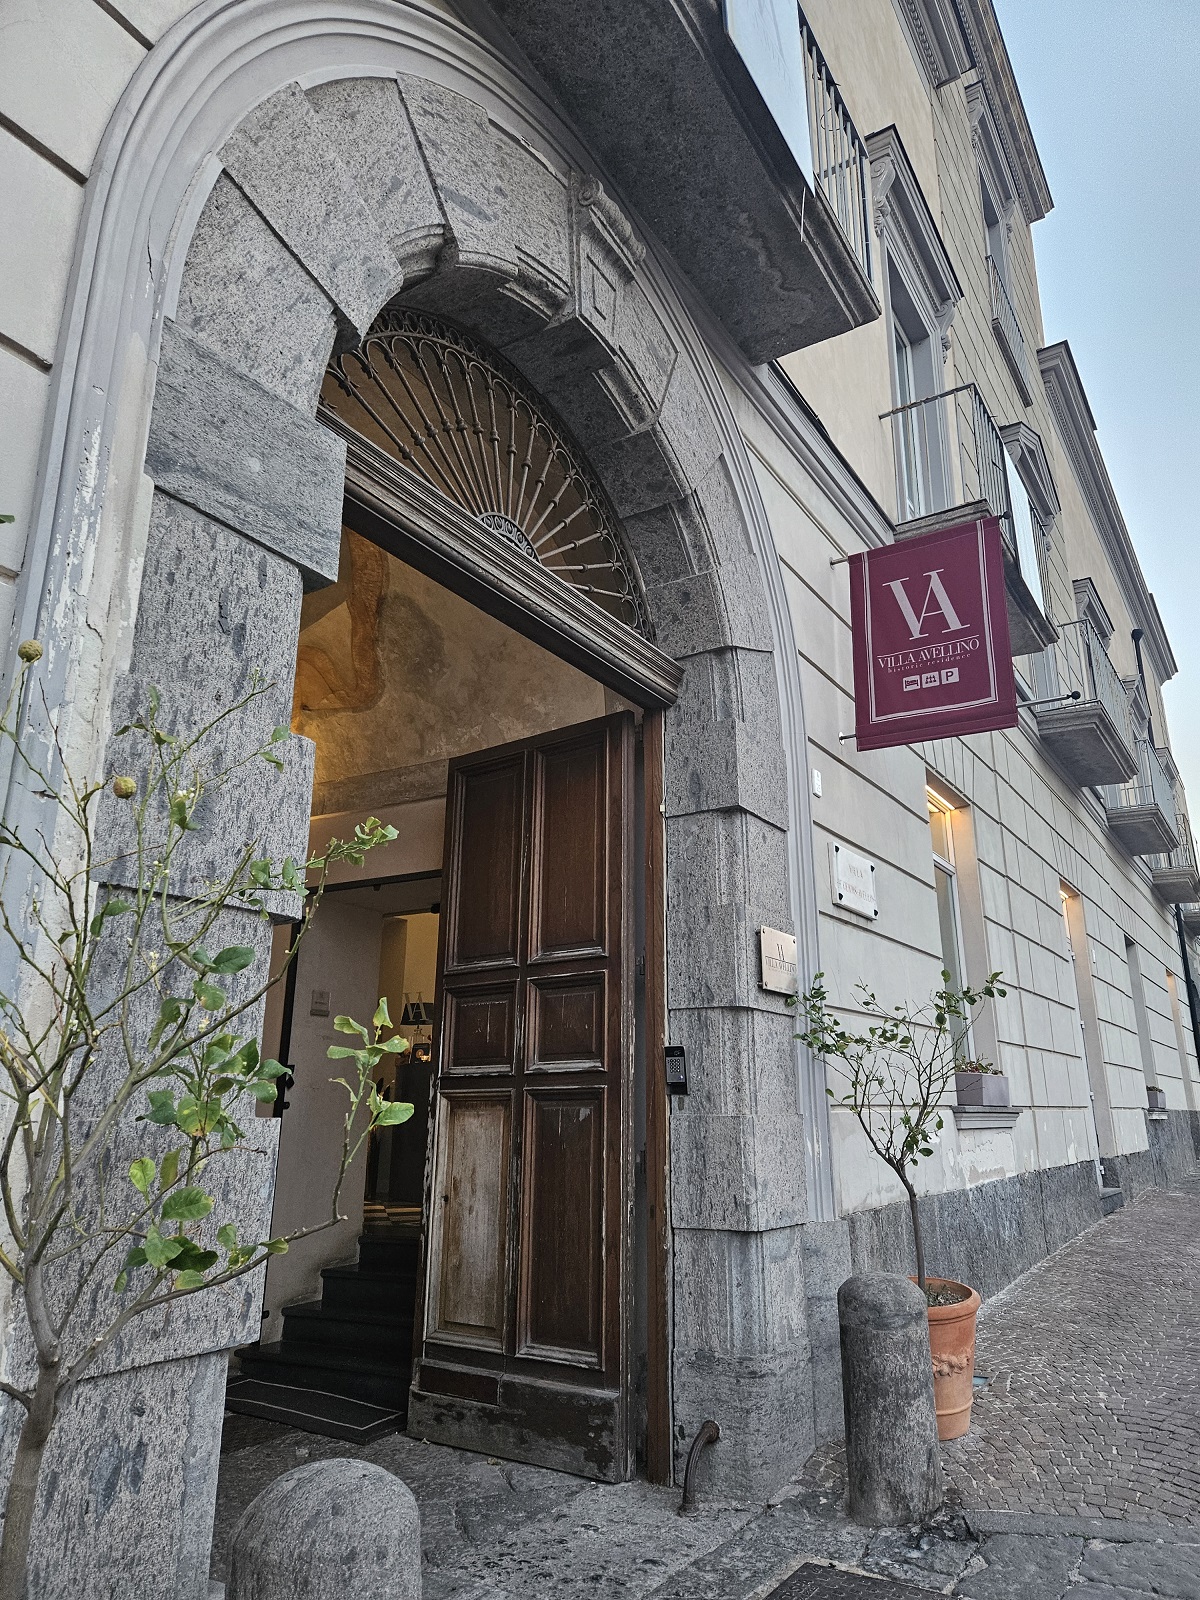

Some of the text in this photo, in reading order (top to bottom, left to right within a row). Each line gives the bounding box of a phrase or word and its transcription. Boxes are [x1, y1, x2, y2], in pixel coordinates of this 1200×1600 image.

[882, 568, 970, 640] VA
[877, 638, 980, 669] VILLA AVELLINO
[888, 653, 971, 674] historic residence
[945, 671, 954, 681] P
[402, 991, 429, 1021] VA
